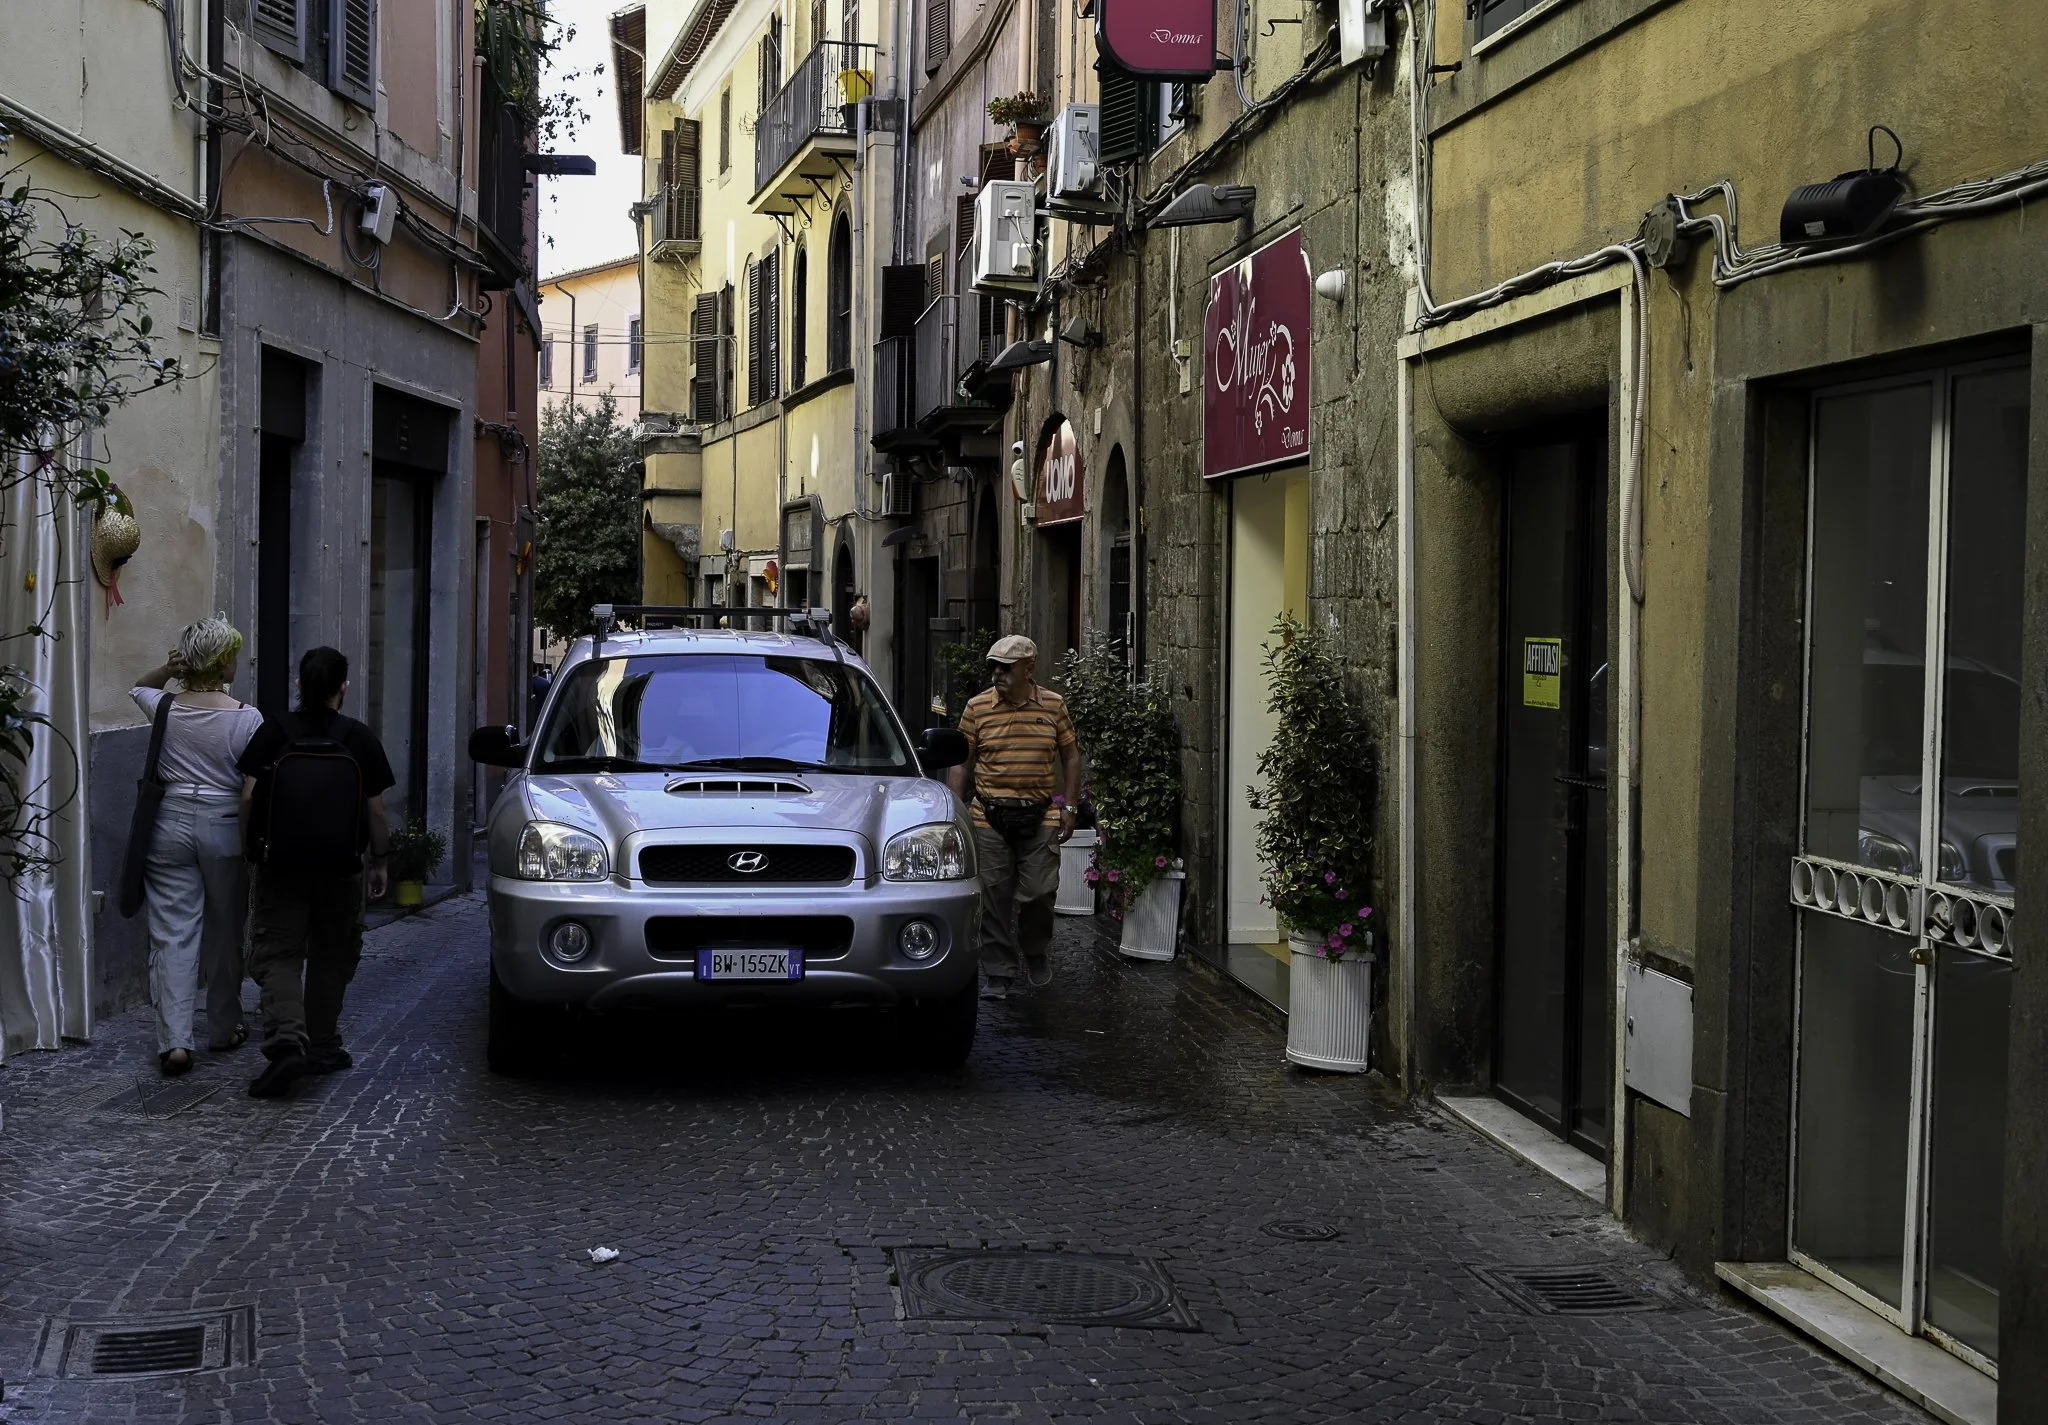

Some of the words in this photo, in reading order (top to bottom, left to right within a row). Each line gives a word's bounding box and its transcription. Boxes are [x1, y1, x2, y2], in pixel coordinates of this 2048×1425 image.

[1150, 29, 1203, 44] Donna
[1216, 296, 1272, 400] Mujer
[1046, 454, 1075, 504] UOMO
[1527, 644, 1559, 673] AFFITTASI
